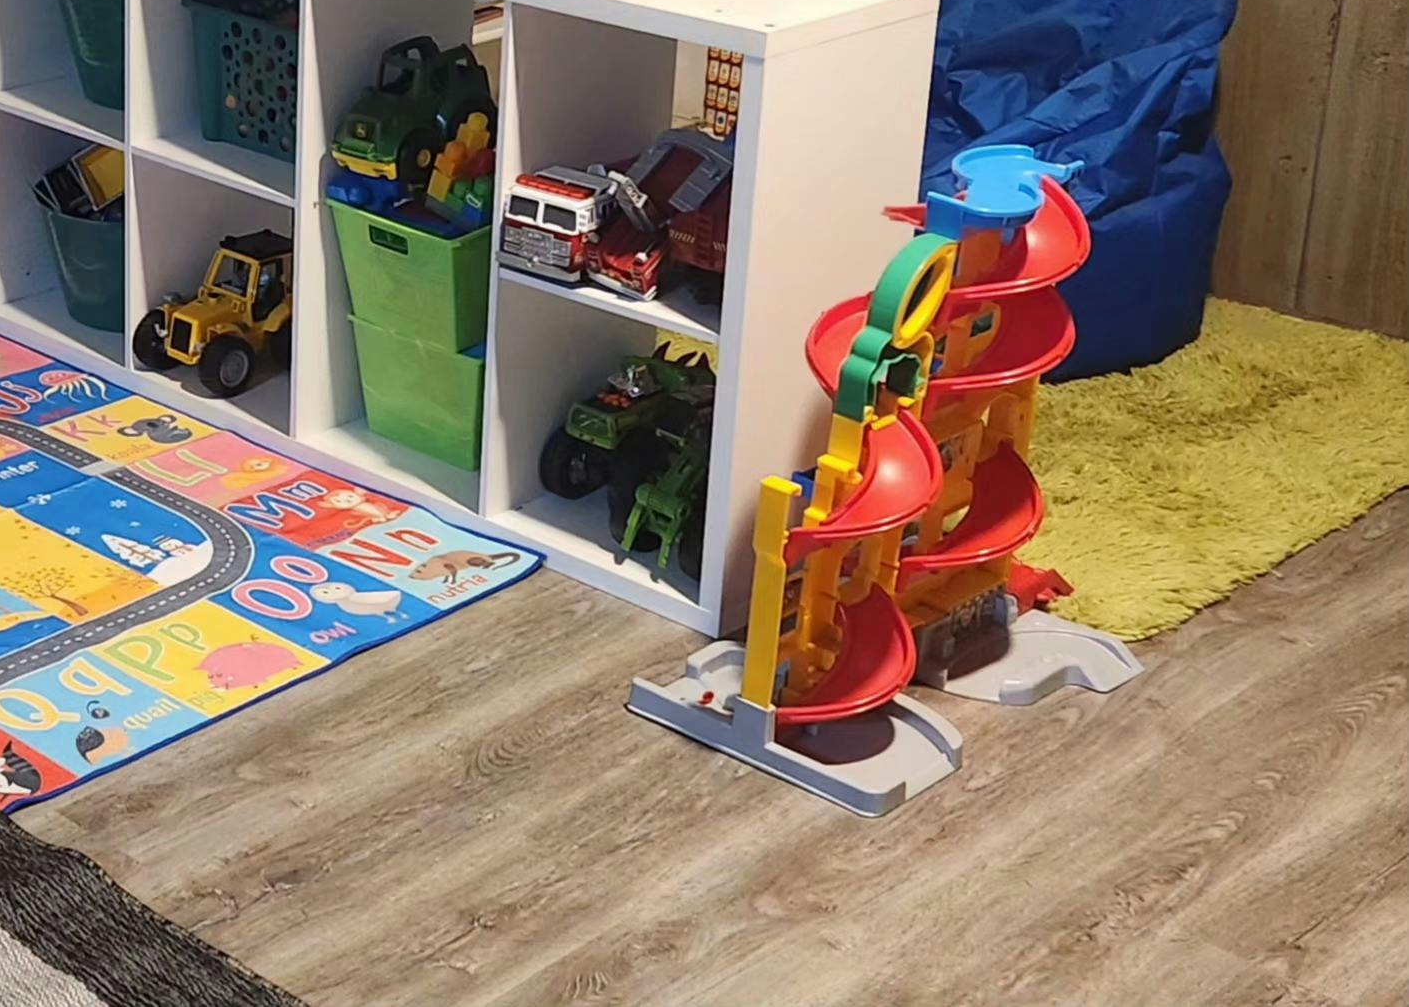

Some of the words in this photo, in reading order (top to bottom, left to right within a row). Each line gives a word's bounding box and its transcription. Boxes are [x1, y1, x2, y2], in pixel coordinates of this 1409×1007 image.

[426, 573, 487, 605] nutria
[310, 622, 359, 646] owl
[191, 688, 225, 710] pig
[123, 696, 181, 732] quail
